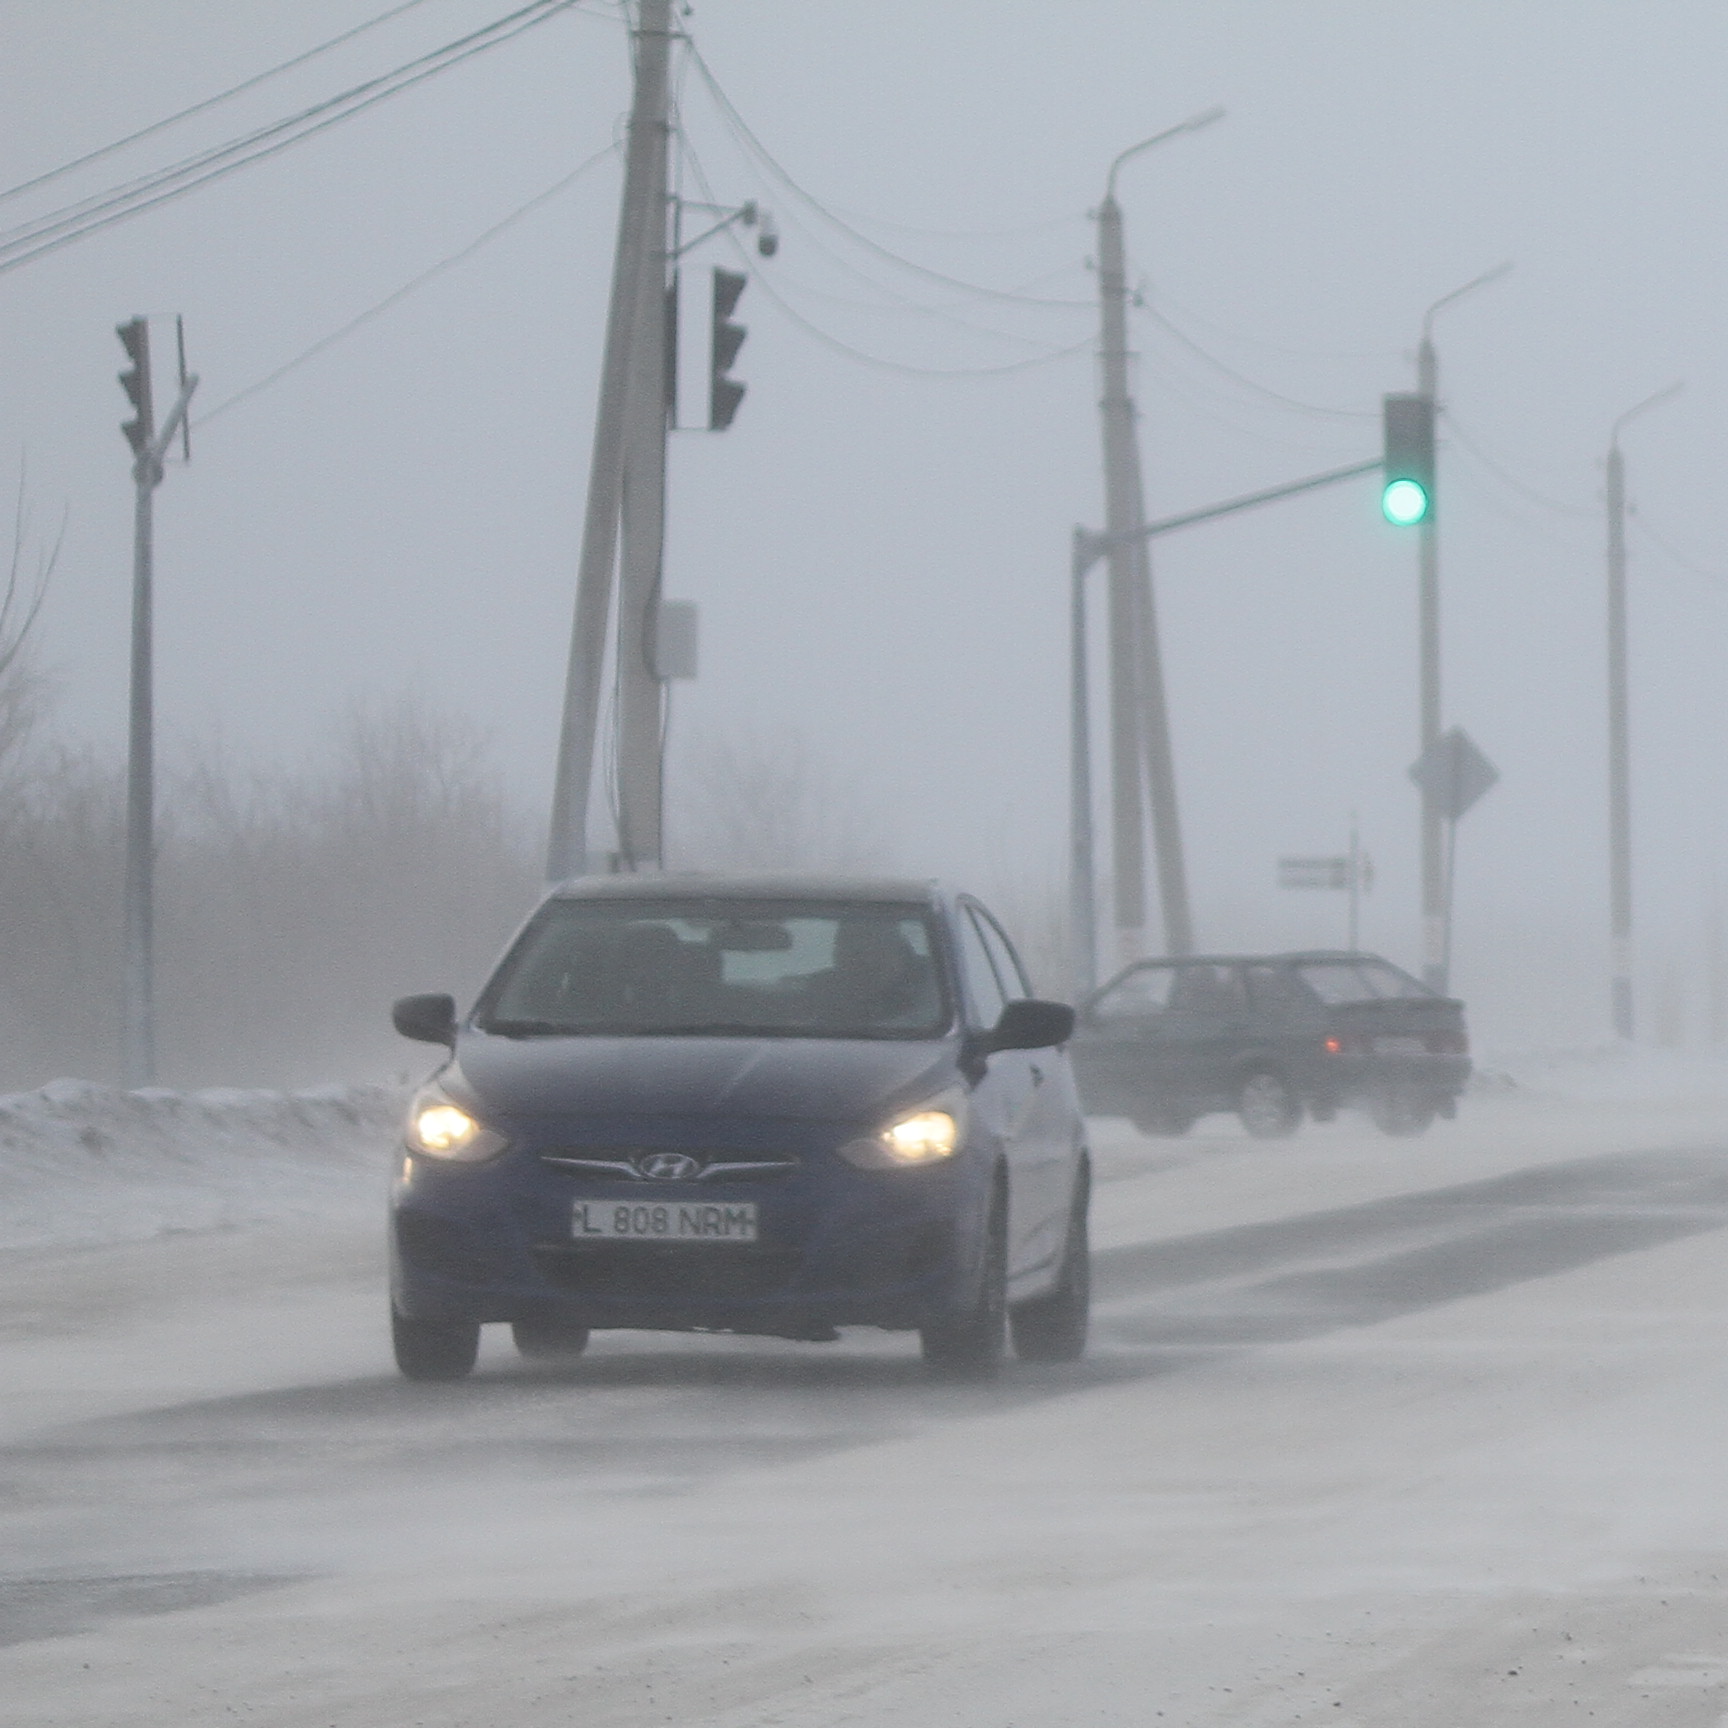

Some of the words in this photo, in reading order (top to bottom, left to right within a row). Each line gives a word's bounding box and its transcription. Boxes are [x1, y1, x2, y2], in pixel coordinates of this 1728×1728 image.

[582, 1204, 603, 1234] L
[613, 1205, 669, 1235] 808
[679, 1207, 748, 1236] NRM
